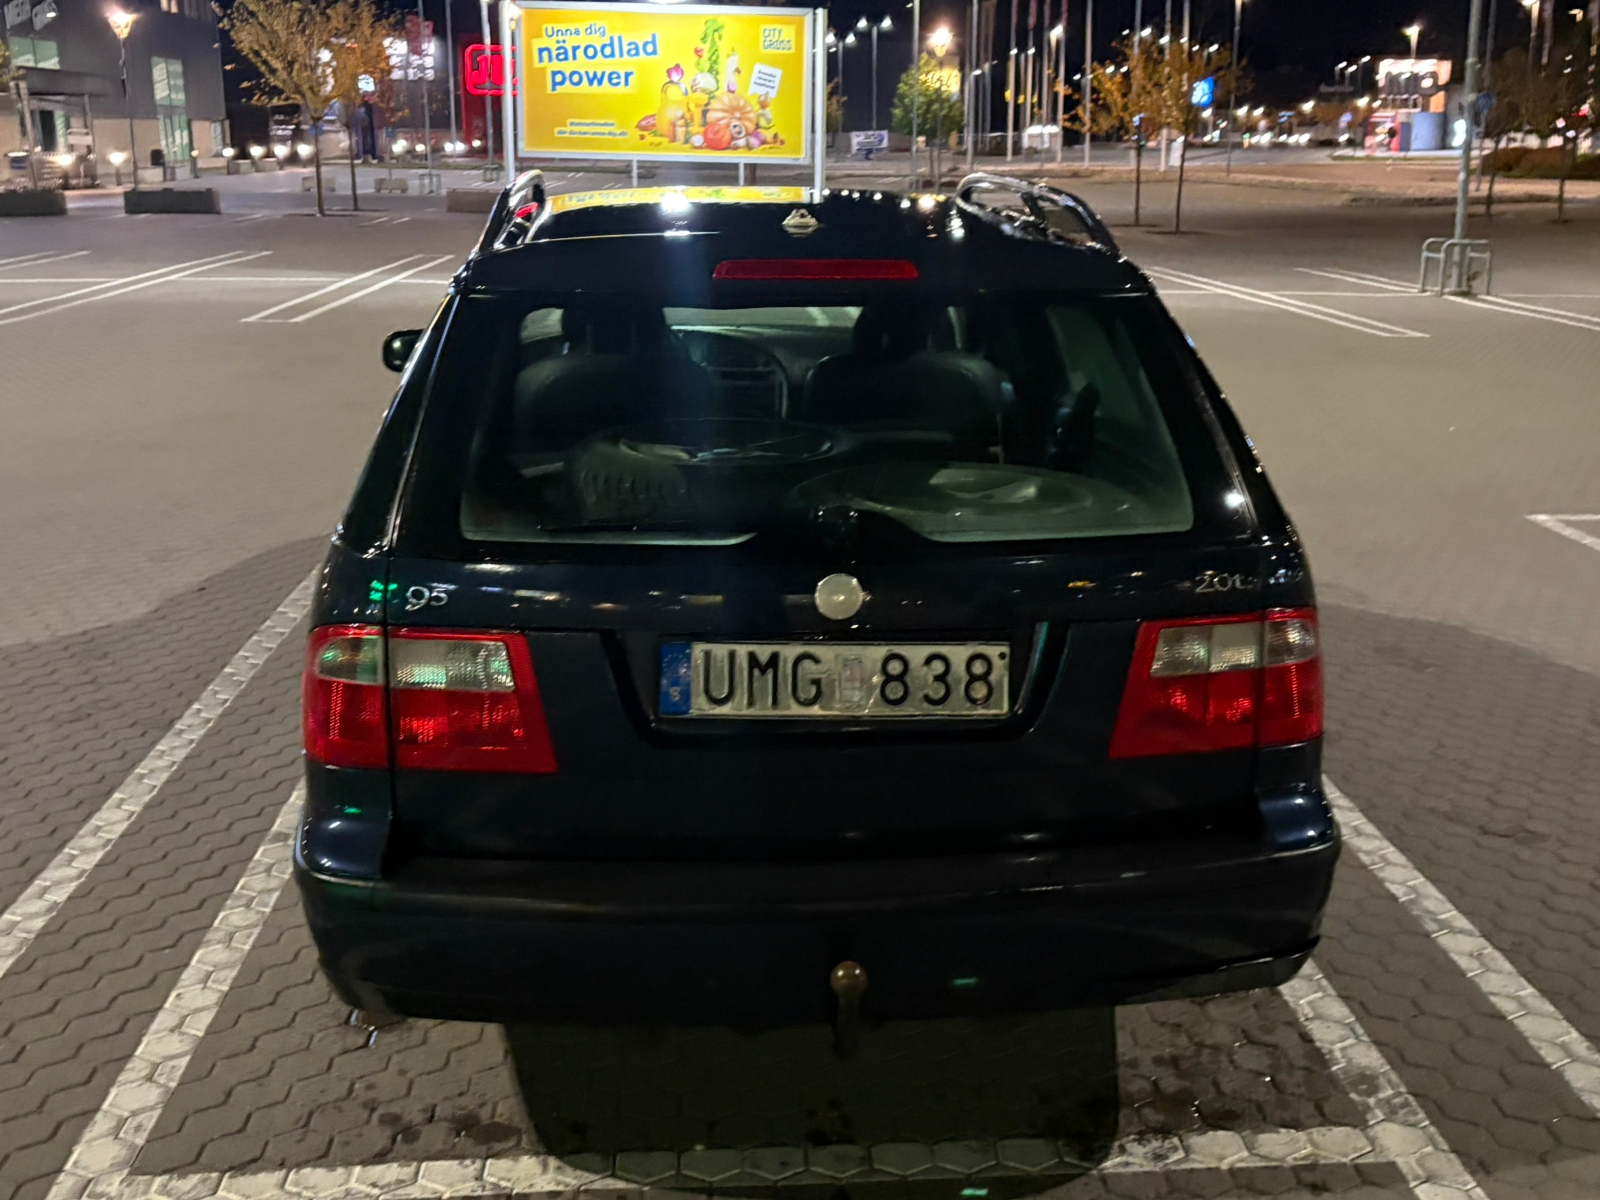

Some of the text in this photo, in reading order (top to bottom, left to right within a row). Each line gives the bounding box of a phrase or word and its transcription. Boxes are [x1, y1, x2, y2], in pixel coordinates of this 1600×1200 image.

[545, 23, 607, 38] Unna dig
[763, 27, 783, 39] CITY
[537, 33, 659, 64] närodlad
[762, 39, 793, 51] GROSS
[550, 70, 634, 93] power
[405, 585, 449, 611] 95
[702, 649, 994, 707] UMG 838
